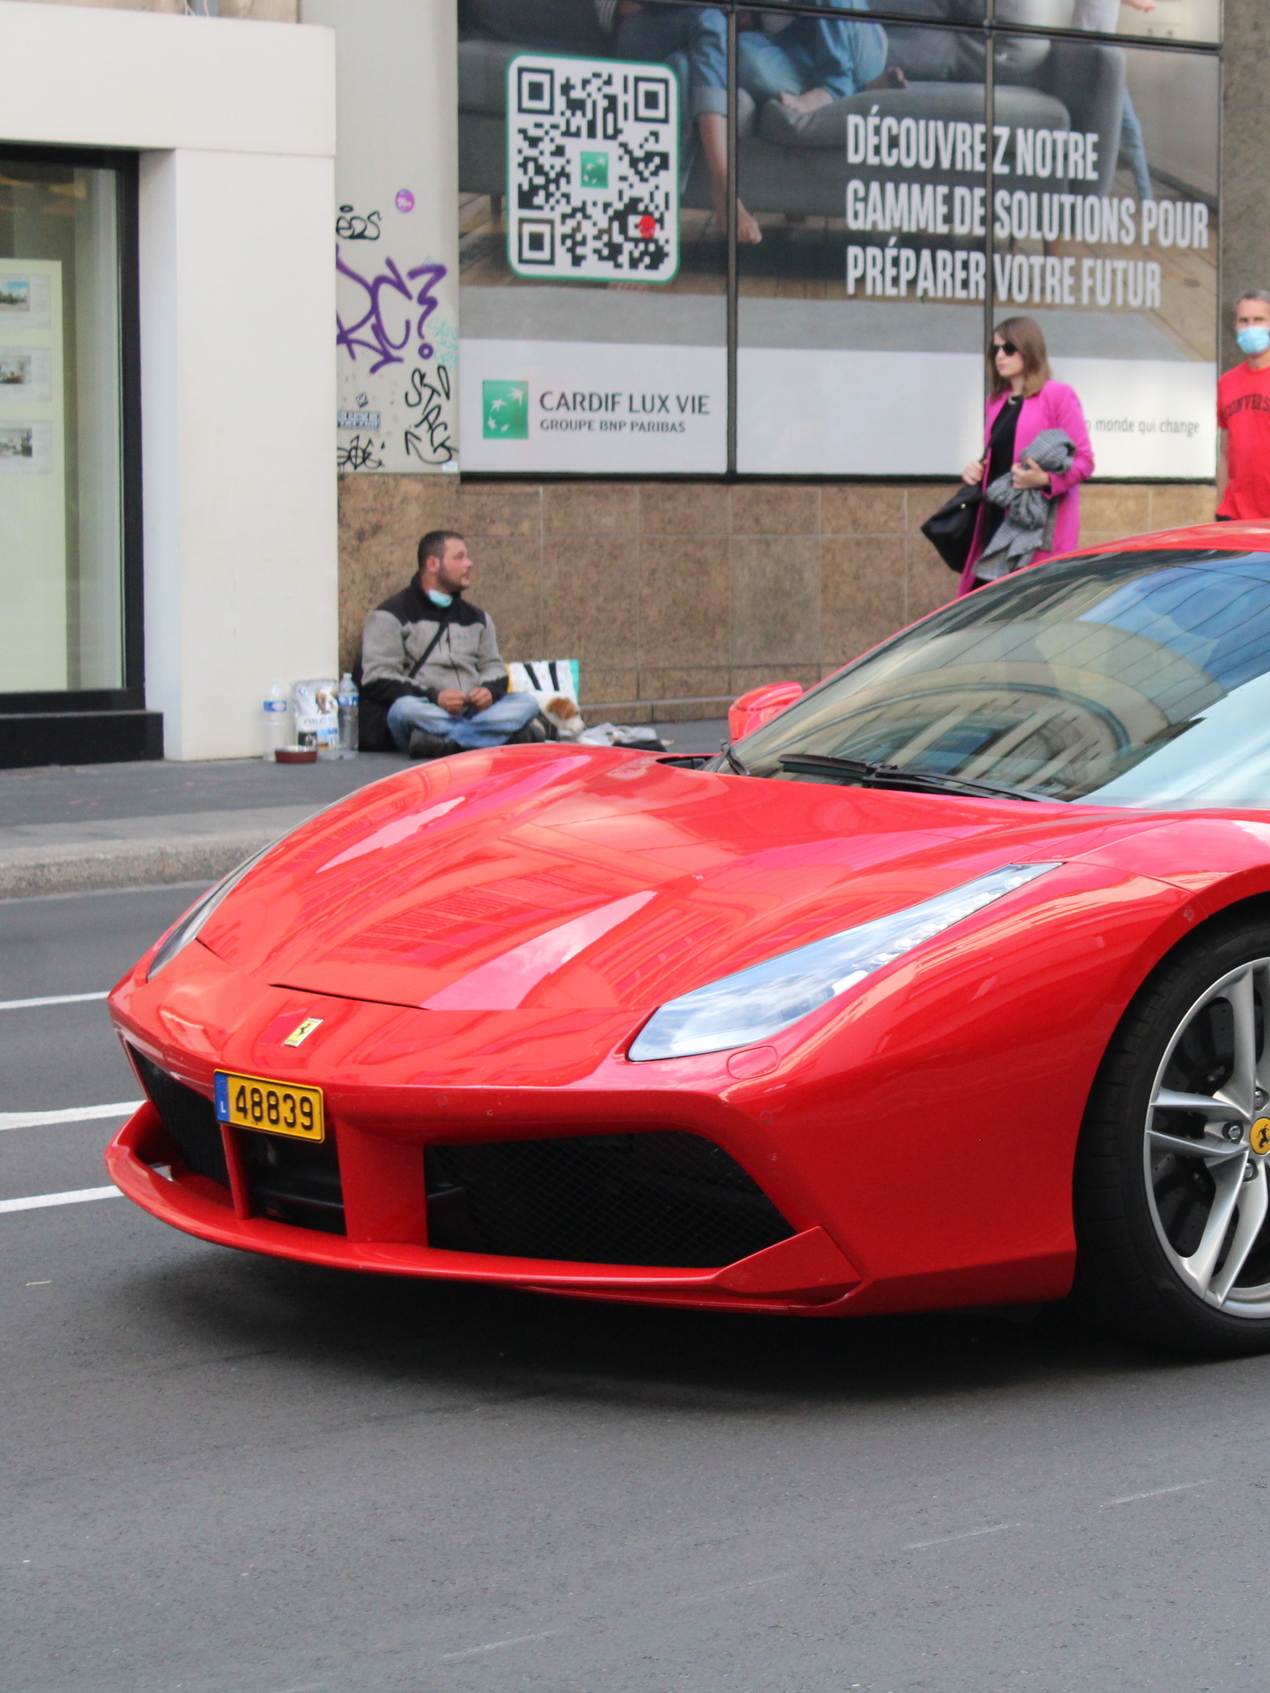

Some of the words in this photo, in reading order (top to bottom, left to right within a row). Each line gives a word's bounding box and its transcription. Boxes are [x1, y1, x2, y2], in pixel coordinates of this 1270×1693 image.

[846, 104, 1011, 175] DÉCOUVREZ
[1015, 127, 1100, 181] NOTRE
[846, 179, 950, 235] GAMME
[953, 186, 987, 236] DE
[994, 190, 1137, 246] SOLUTIONS
[1142, 199, 1209, 250] POUR
[846, 235, 987, 300] PRÉPARER
[994, 254, 1076, 306] VOTRE
[1082, 257, 1162, 308] FUTUR
[539, 391, 623, 414] CARDIF
[628, 393, 671, 414] LUX
[676, 395, 711, 415] VIE
[540, 418, 596, 431] GROUPE
[600, 420, 627, 432] BNP
[630, 420, 686, 433] PARIBAS
[1095, 416, 1135, 432] monde
[1138, 417, 1156, 436] qui
[1159, 418, 1200, 438] change
[220, 1100, 227, 1113] L
[235, 1084, 314, 1131] 48839
